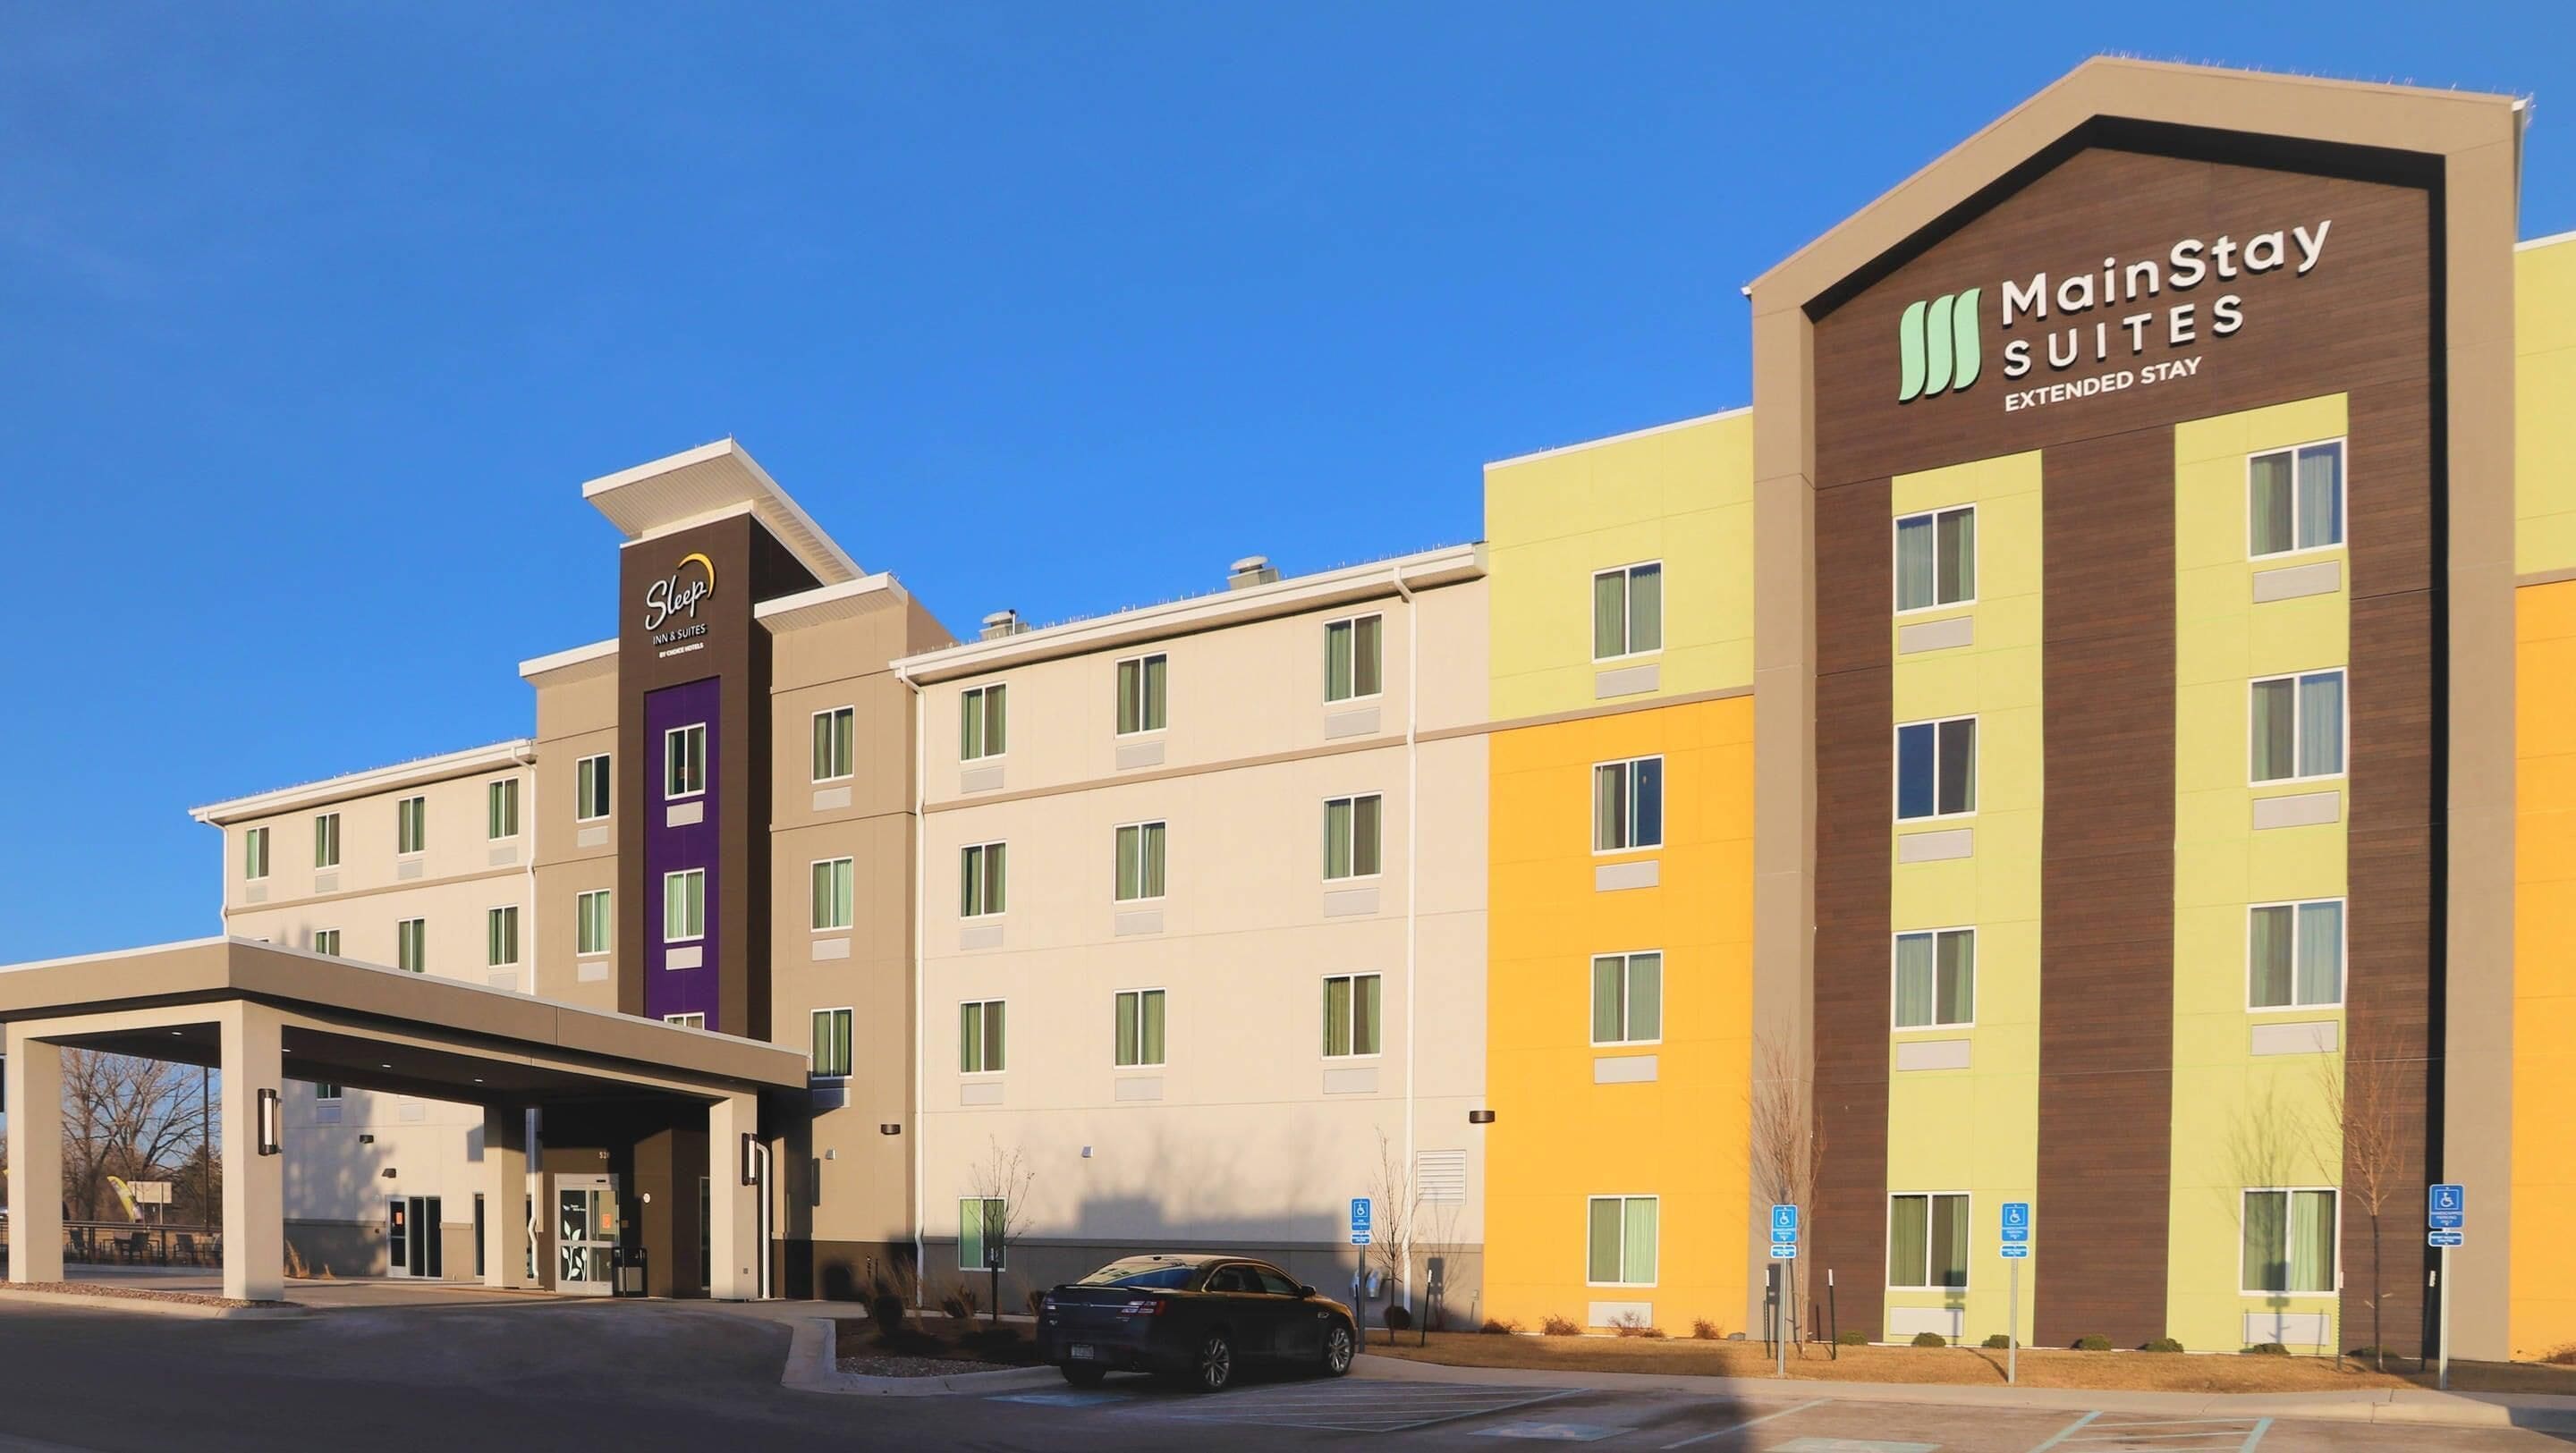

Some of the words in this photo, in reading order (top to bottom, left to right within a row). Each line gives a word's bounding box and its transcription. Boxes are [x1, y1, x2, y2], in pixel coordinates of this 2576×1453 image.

[2001, 220, 2331, 325] MainStay
[2004, 295, 2243, 377] SUITES
[2004, 370, 2134, 412] EXTENDED
[2140, 356, 2203, 384] STAY
[646, 574, 707, 630] Sleep
[653, 633, 668, 645] INN
[670, 630, 677, 641] &
[677, 623, 706, 639] SUITES
